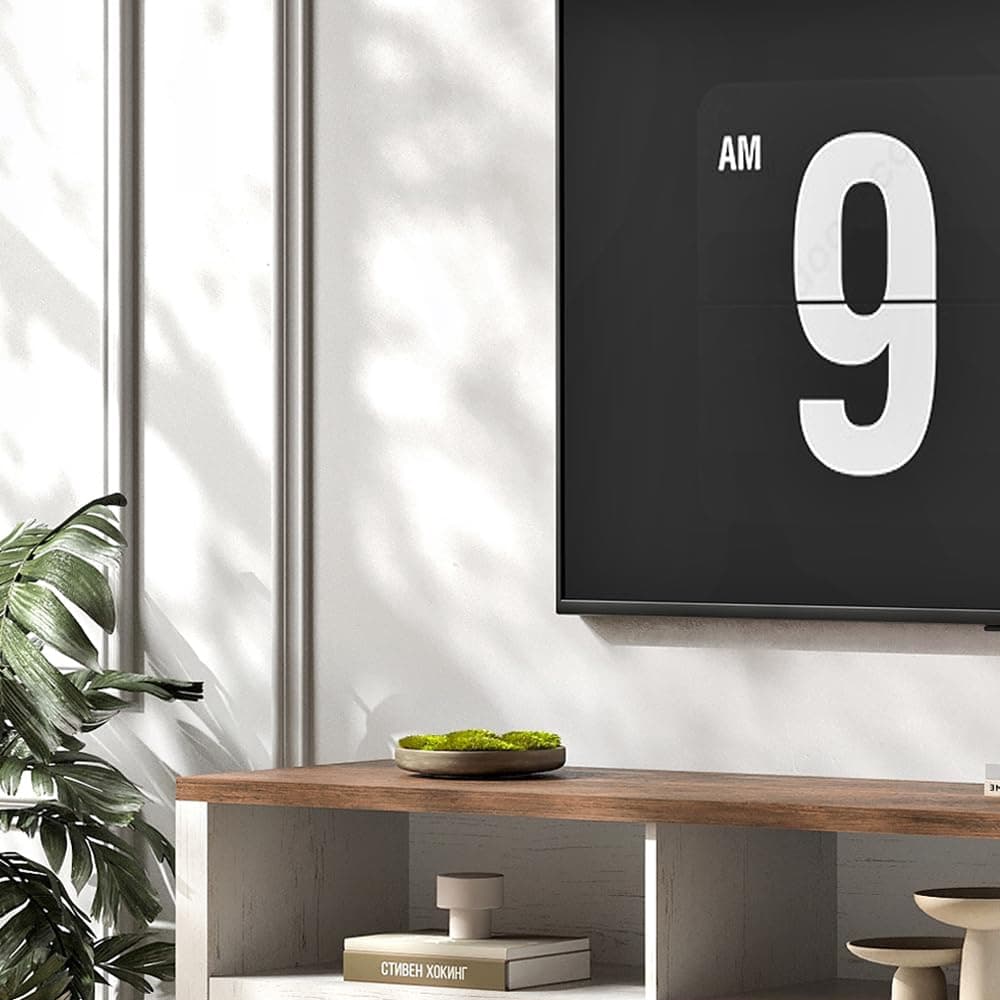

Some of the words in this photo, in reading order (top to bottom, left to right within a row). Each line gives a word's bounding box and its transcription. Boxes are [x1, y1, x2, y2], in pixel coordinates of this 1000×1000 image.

[718, 135, 761, 171] AM
[793, 130, 939, 478] 9
[381, 961, 423, 978] СТИВЕН
[426, 964, 468, 980] ХОКИНГ
